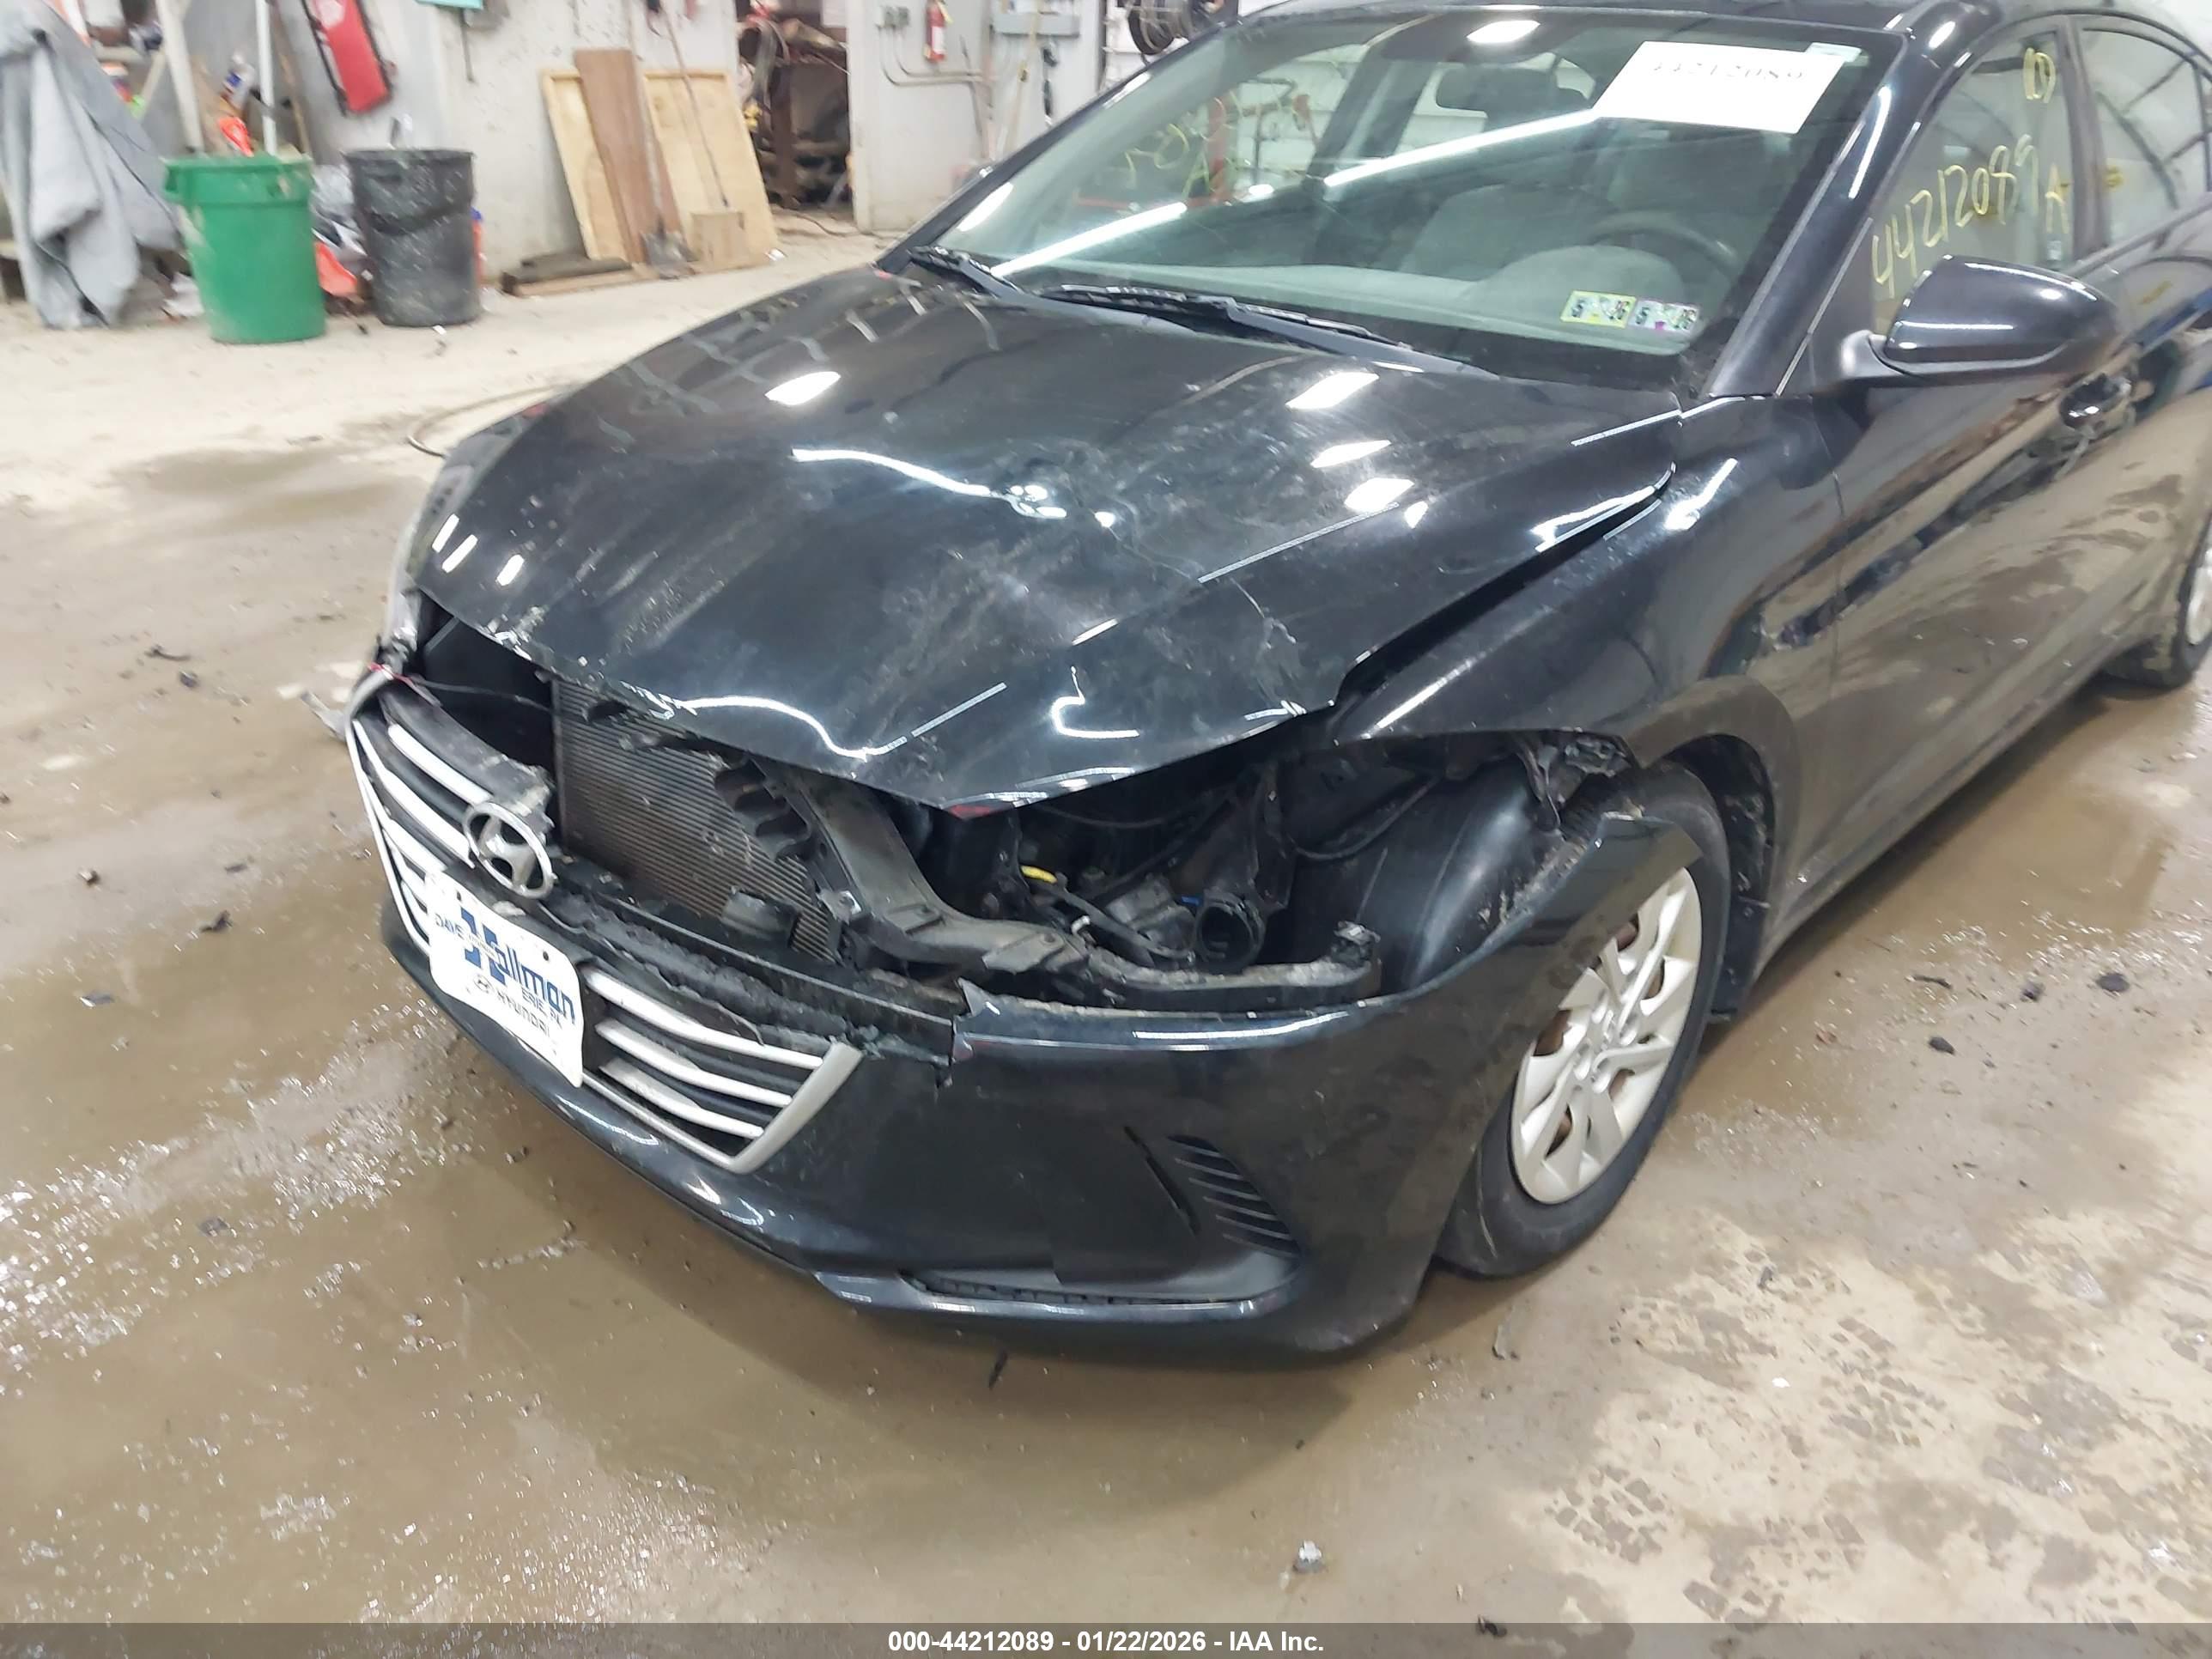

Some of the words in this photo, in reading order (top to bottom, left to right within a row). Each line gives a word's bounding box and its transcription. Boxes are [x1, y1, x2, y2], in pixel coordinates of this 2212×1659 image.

[1871, 133, 2039, 299] 44212089
[435, 914, 465, 939] DAVE
[460, 906, 575, 1024] Hallman
[521, 987, 548, 1018] ERIE
